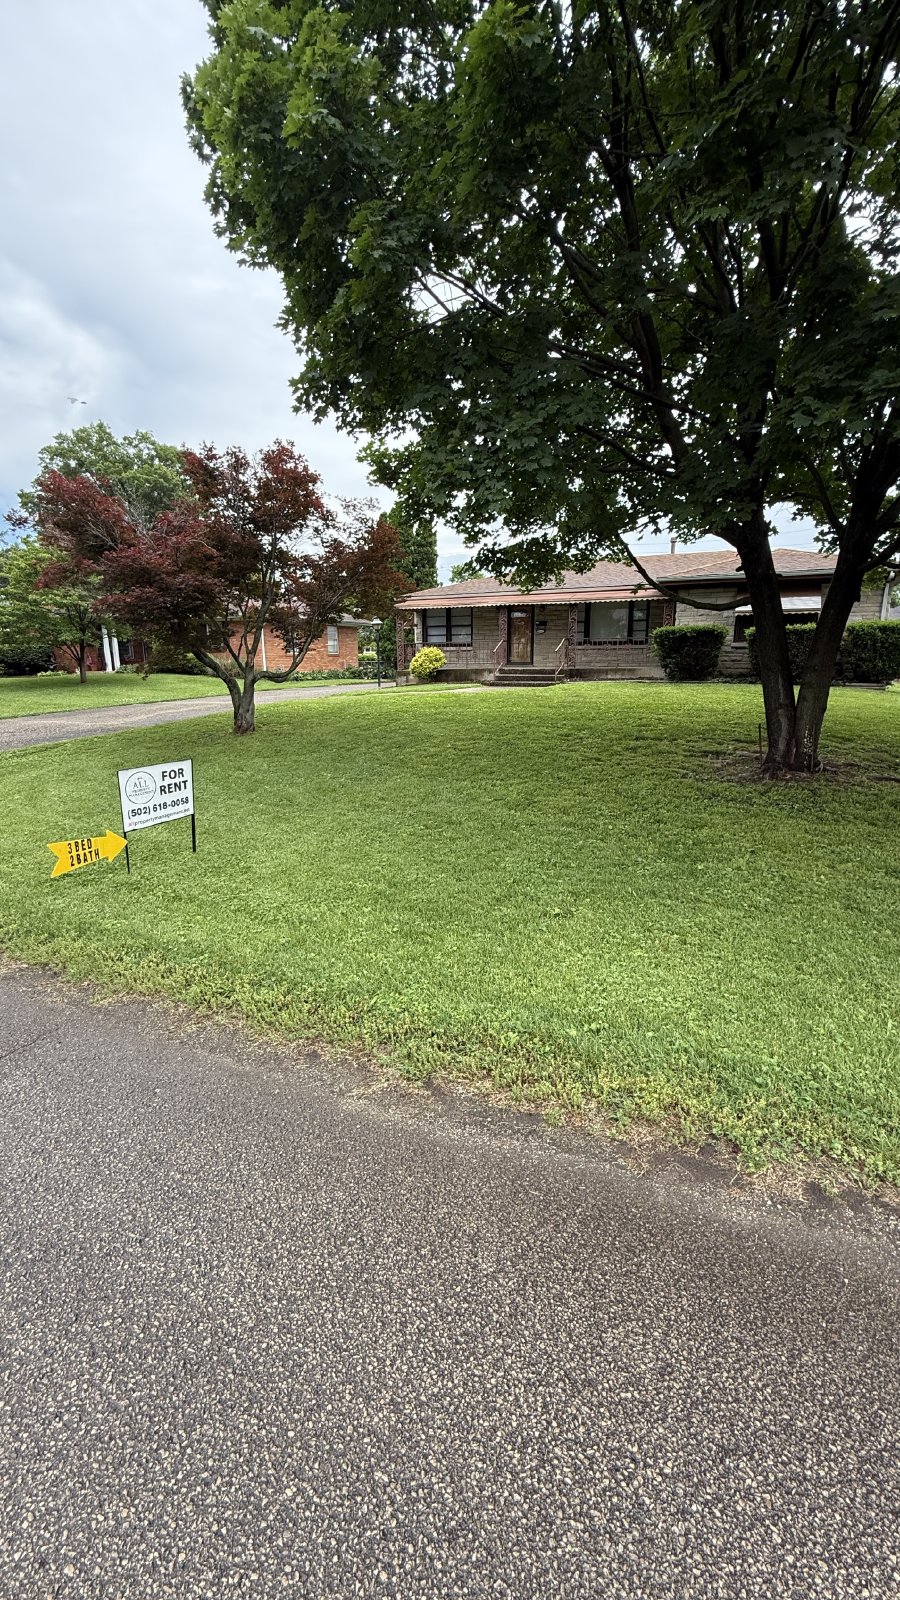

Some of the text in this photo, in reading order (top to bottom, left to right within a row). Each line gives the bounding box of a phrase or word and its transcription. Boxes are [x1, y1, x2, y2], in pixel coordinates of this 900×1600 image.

[161, 768, 185, 781] FOR
[159, 780, 188, 795] RENT
[128, 796, 189, 819] (502) 618-0058
